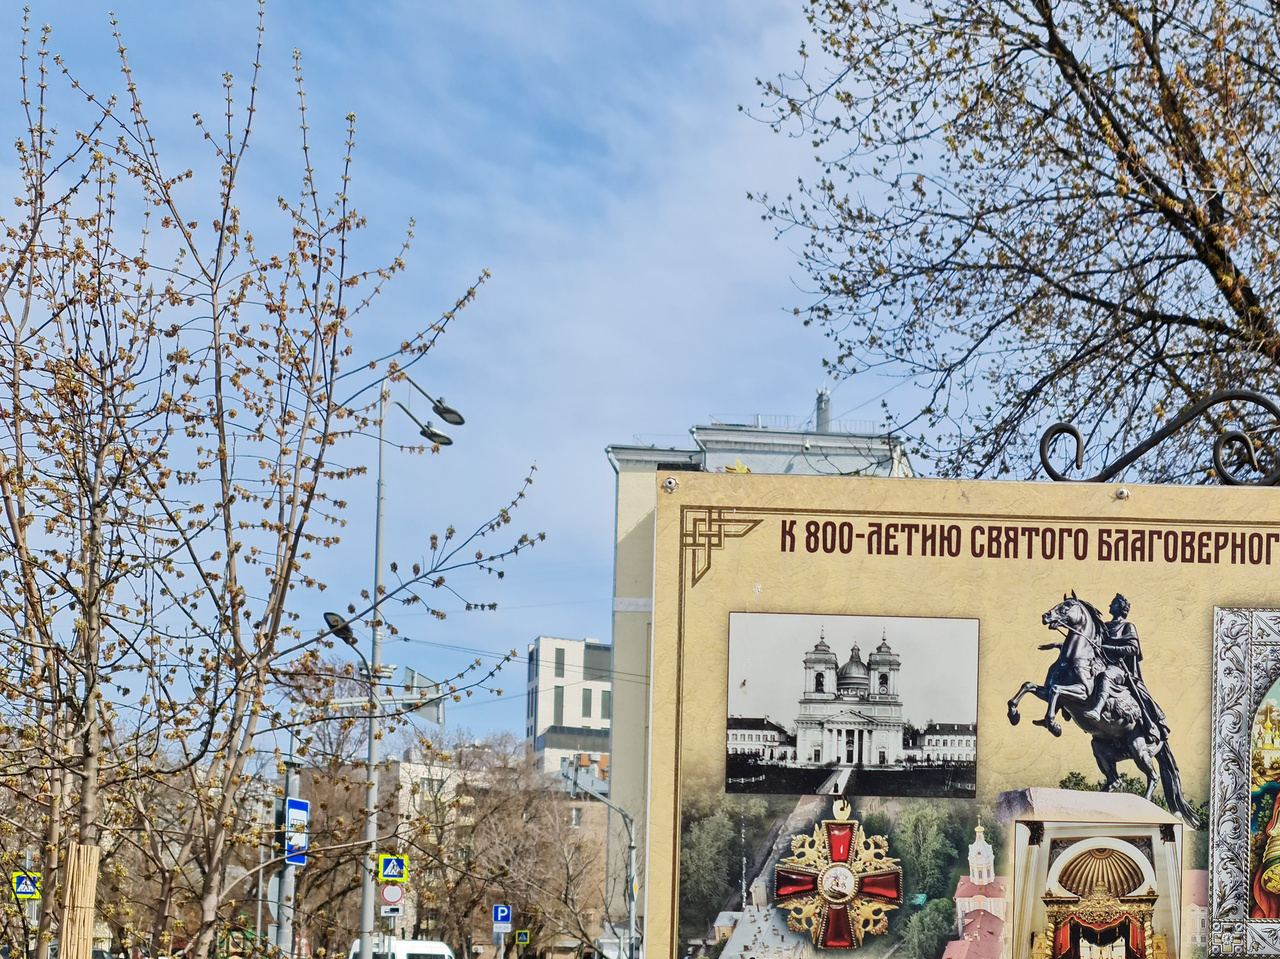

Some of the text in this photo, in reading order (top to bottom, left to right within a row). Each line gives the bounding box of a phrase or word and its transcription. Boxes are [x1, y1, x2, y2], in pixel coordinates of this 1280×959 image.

[780, 519, 796, 552] К
[805, 519, 961, 557] 800-ЛЕТИЮ
[970, 524, 1088, 561] СВЯТОГО
[497, 906, 508, 921] P
